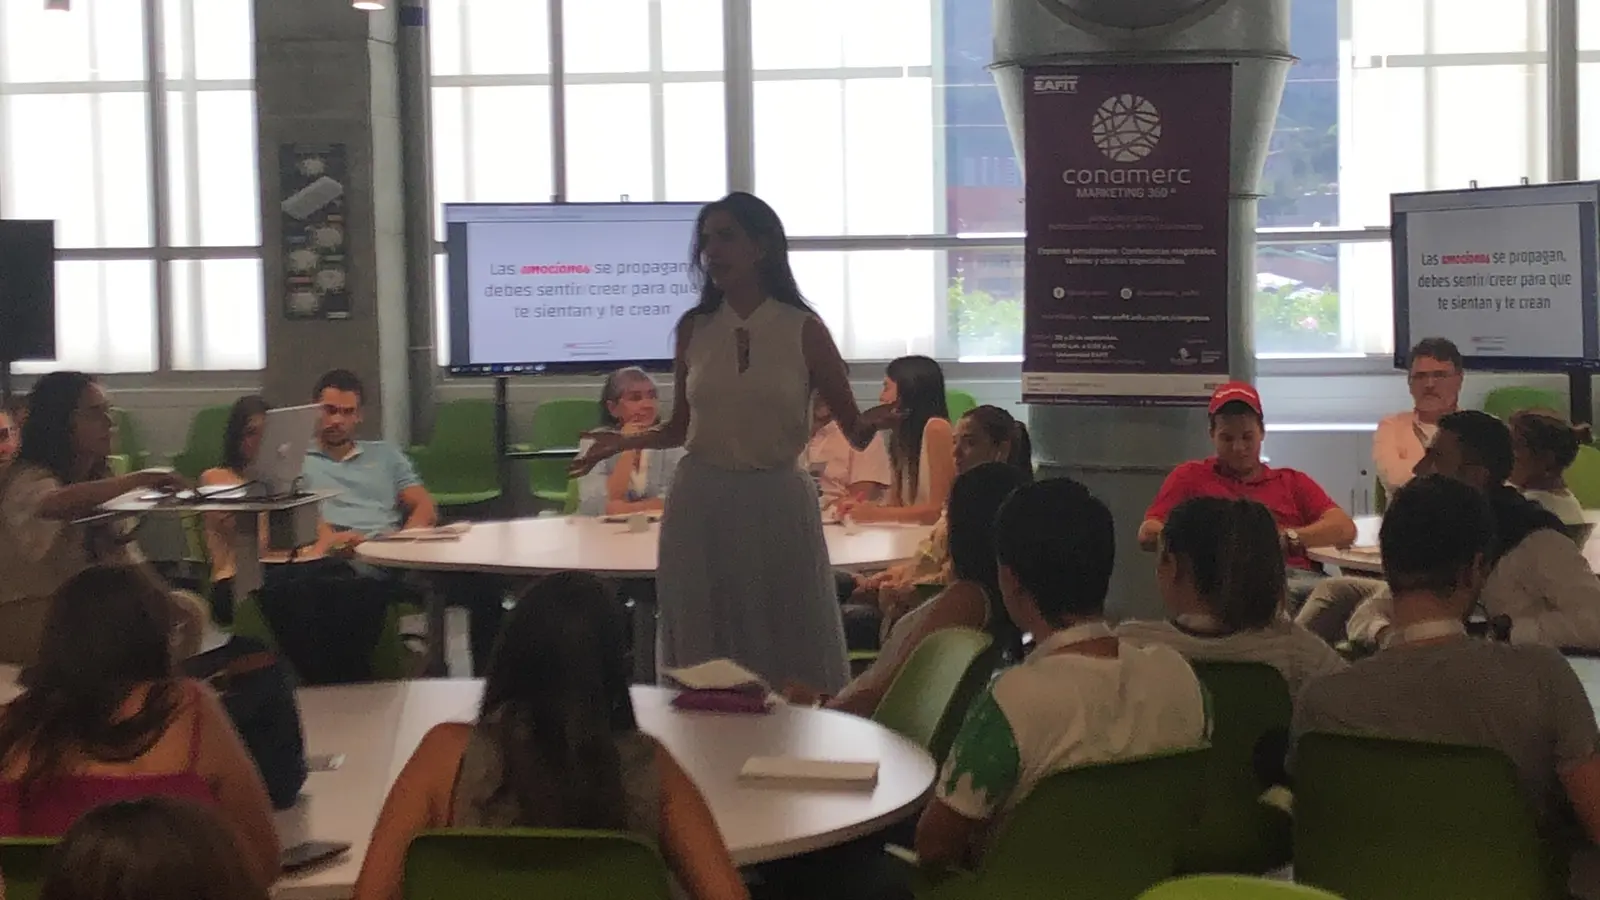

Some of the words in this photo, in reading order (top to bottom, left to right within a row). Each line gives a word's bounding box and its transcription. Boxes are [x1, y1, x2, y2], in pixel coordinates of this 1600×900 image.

[1034, 80, 1078, 91] EAFIT
[1062, 168, 1191, 185] conamerc
[1076, 187, 1144, 198] MARKETING
[1421, 252, 1439, 266] Las
[1492, 252, 1506, 264] se
[490, 262, 515, 276] Las
[594, 262, 611, 274] se
[1418, 275, 1450, 288] debes
[1520, 275, 1546, 288] para
[1550, 273, 1572, 288] que
[485, 283, 532, 298] debes
[632, 283, 666, 297] para
[670, 283, 698, 297] que
[1438, 297, 1448, 310] te
[1451, 295, 1492, 310] sientan
[1495, 297, 1502, 312] y
[1505, 296, 1515, 309] te
[1519, 296, 1551, 309] crean
[514, 306, 529, 318] te
[534, 304, 592, 318] sientan
[597, 306, 605, 320] y
[609, 304, 624, 317] te
[629, 304, 671, 316] crean
